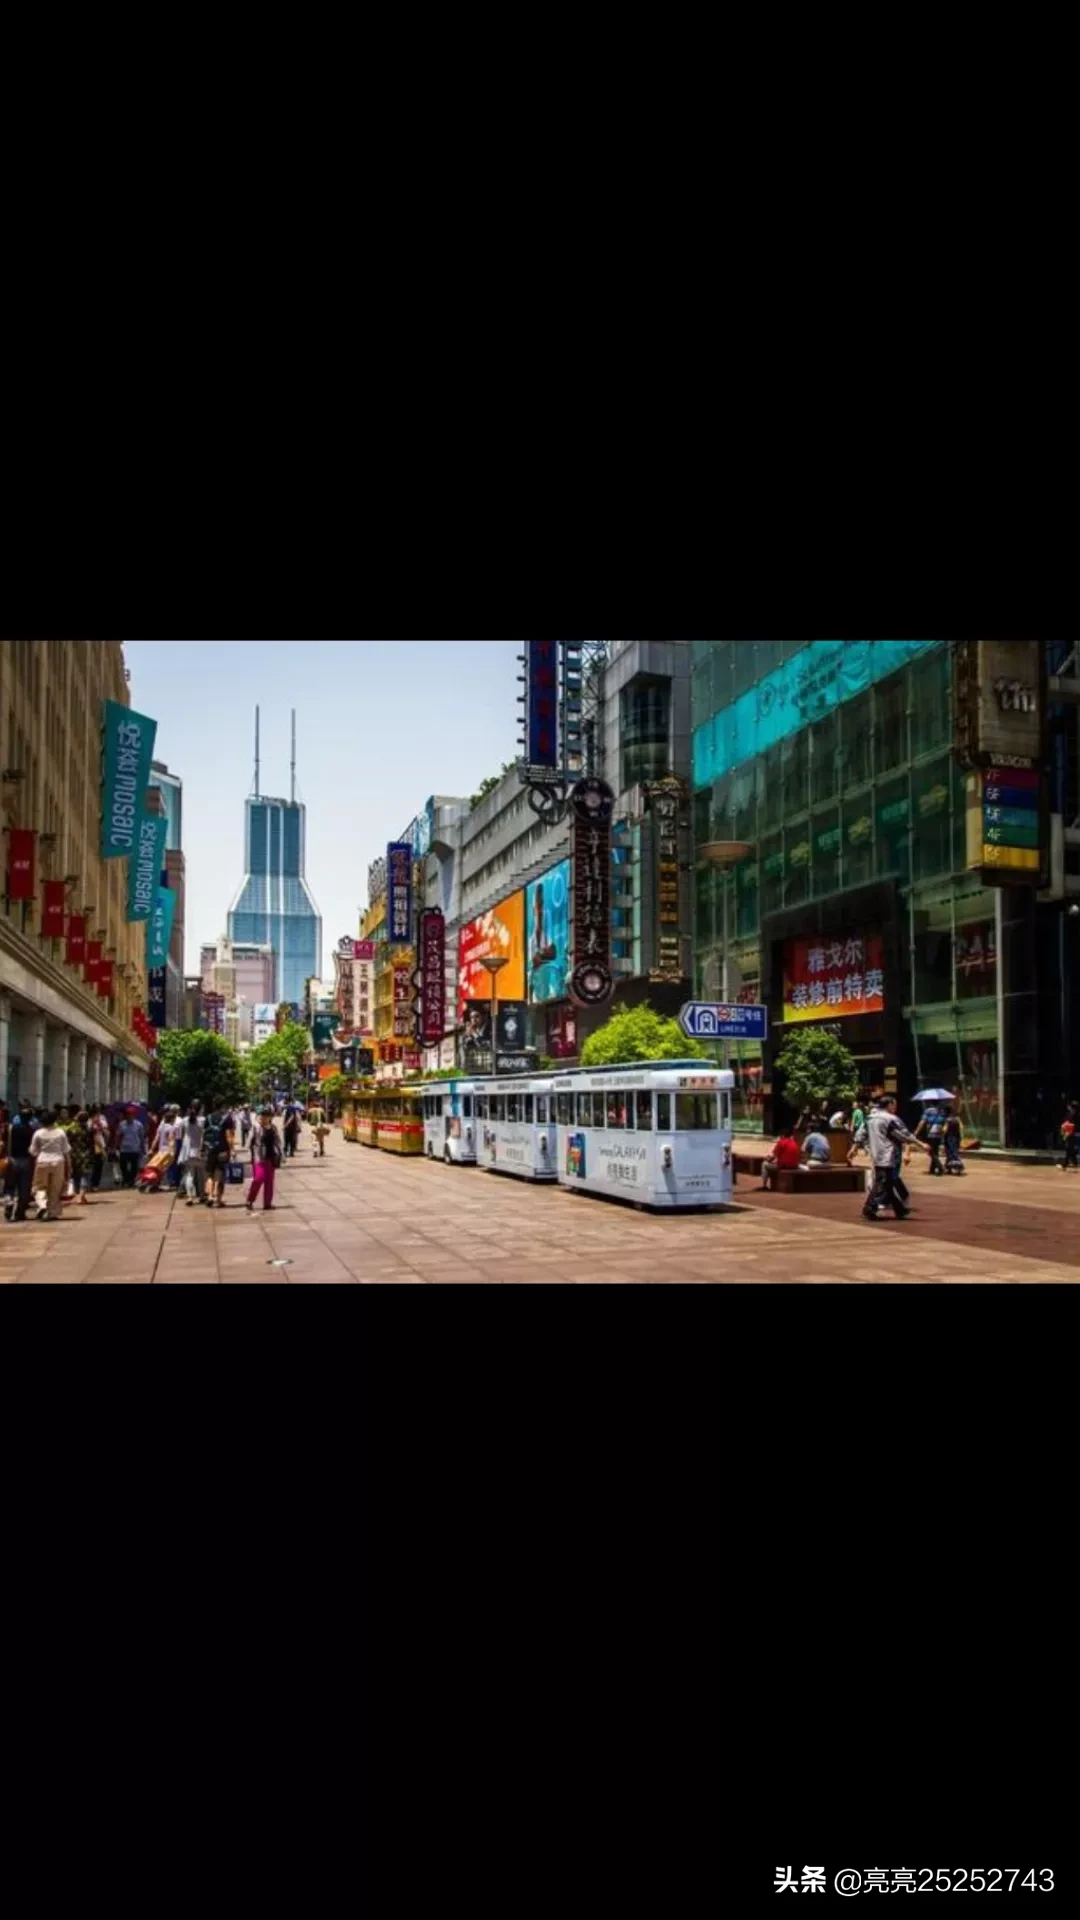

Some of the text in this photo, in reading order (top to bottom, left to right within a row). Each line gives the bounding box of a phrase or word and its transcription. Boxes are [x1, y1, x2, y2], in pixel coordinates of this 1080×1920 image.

[807, 938, 862, 974] 雅戈尔
[792, 968, 884, 1009] 装修前特卖
